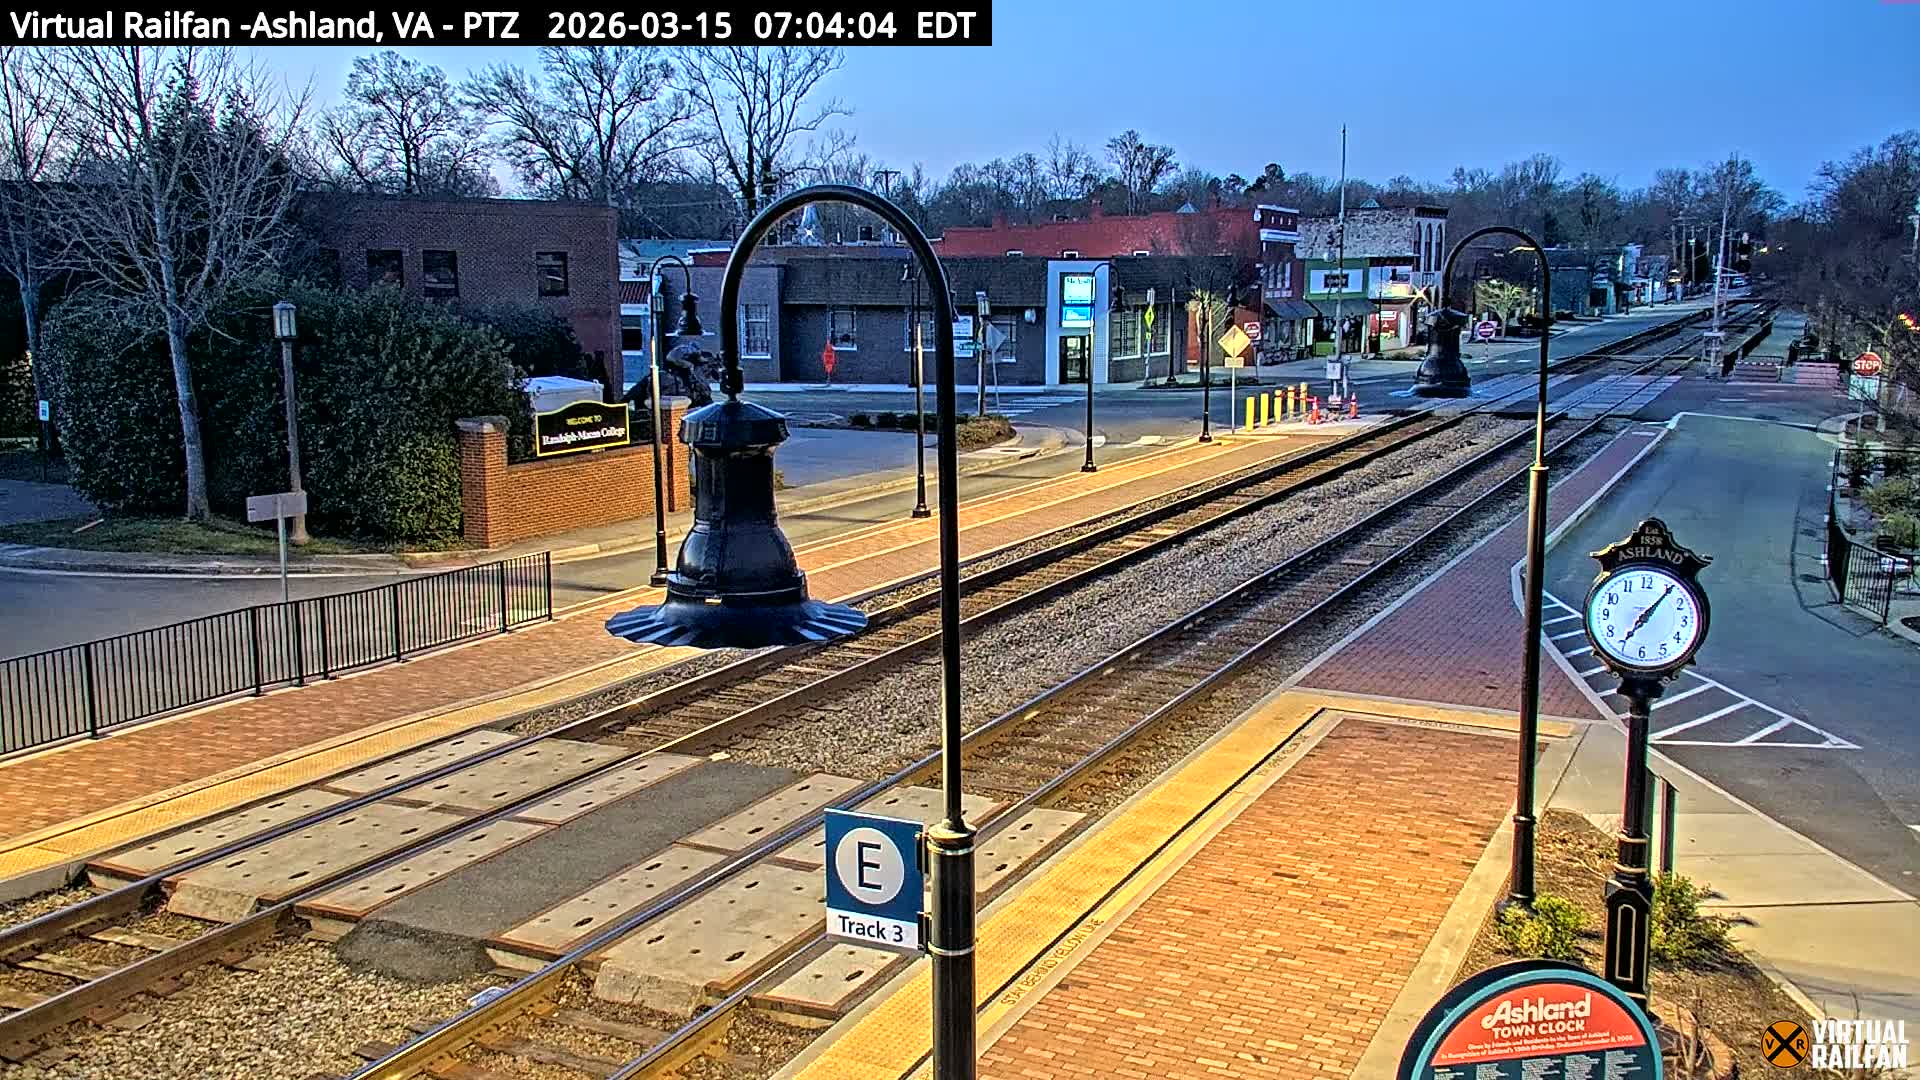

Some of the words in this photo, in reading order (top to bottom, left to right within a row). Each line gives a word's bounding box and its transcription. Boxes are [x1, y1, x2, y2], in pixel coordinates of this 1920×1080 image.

[1854, 359, 1880, 370] STOP
[566, 416, 593, 426] WELCOME
[594, 414, 602, 422] TO
[542, 430, 601, 445] Randolph-Macon
[601, 426, 625, 438] College
[1640, 535, 1663, 545] 1858
[1619, 546, 1683, 565] ASHLAND
[1624, 580, 1632, 592] 11
[1641, 576, 1653, 589] 12
[1608, 593, 1619, 605] 10
[1676, 597, 1684, 611] 2
[1602, 608, 1610, 620] 9
[1680, 615, 1688, 627] 3
[1606, 625, 1614, 637] 8
[1673, 631, 1681, 643] 4
[1618, 639, 1626, 653] 7
[1638, 646, 1646, 658] 6
[1658, 643, 1667, 655] 5
[858, 841, 882, 890] E
[838, 914, 886, 940] Track
[892, 925, 903, 943] 3
[1001, 986, 1026, 1006] STAY
[1023, 958, 1058, 987] BEHIND
[1054, 931, 1087, 958] YELLOW
[1481, 992, 1591, 1029] Ashland
[1492, 1024, 1536, 1039] TOWN
[1539, 1019, 1585, 1034] CLOCK
